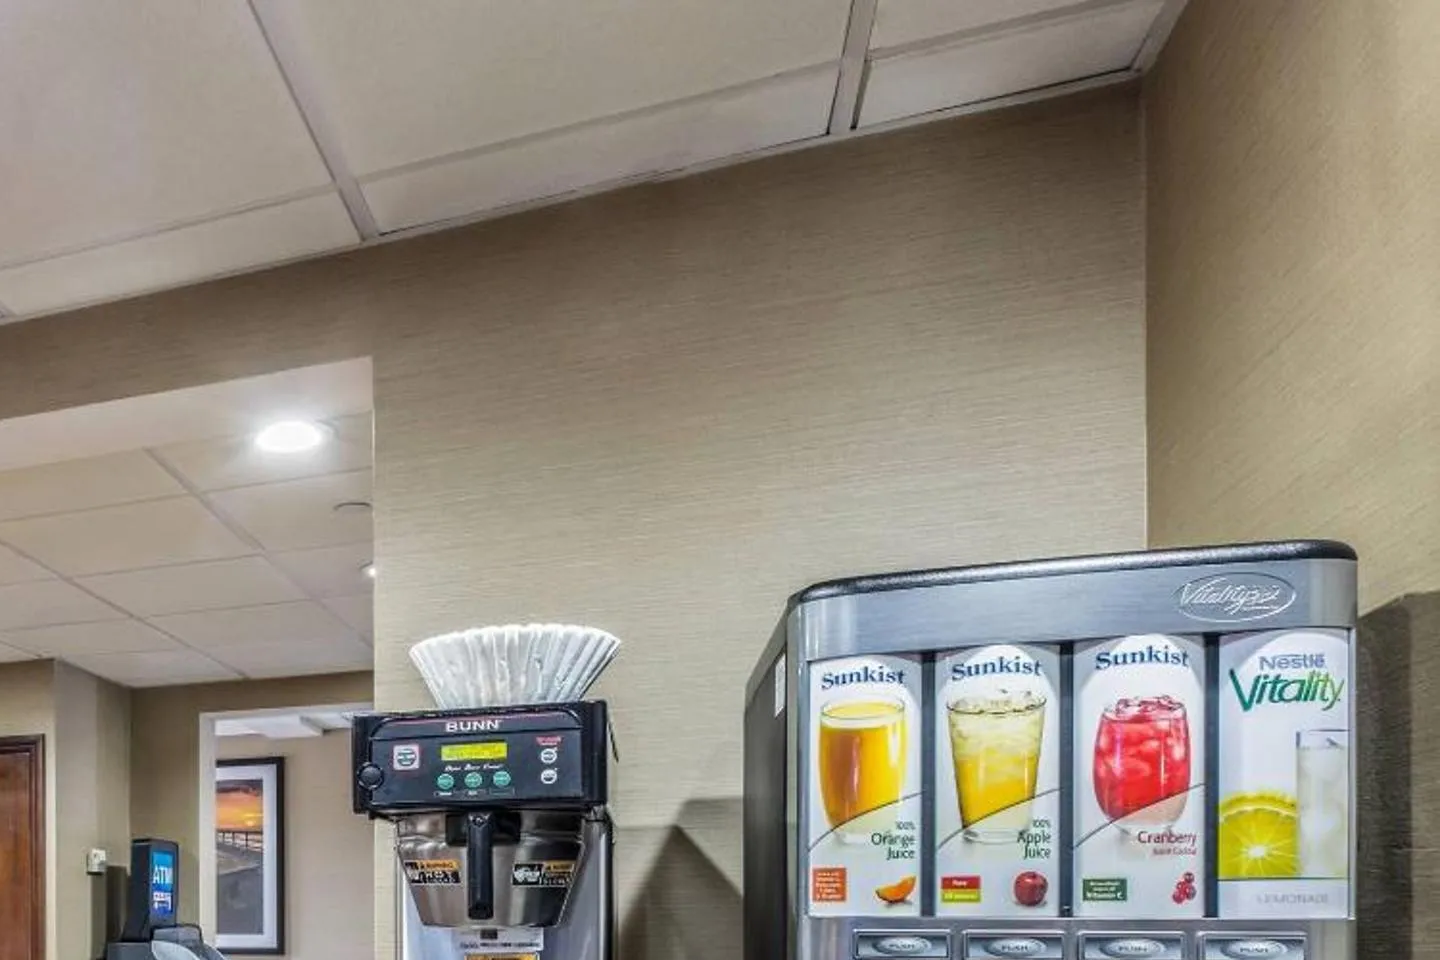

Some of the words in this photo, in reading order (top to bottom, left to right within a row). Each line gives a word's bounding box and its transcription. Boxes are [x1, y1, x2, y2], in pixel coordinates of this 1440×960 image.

[1095, 645, 1189, 670] Sunkist
[951, 656, 1042, 681] Sunkist
[821, 666, 905, 690] Sunkist
[1228, 669, 1345, 712] Vitality
[445, 720, 500, 732] BUNN
[871, 832, 915, 848] Orange
[1017, 829, 1051, 846] Apple
[1137, 830, 1197, 847] Cranberry
[886, 847, 915, 861] Juice
[1023, 844, 1051, 860] Juice
[152, 865, 173, 884] ATM
